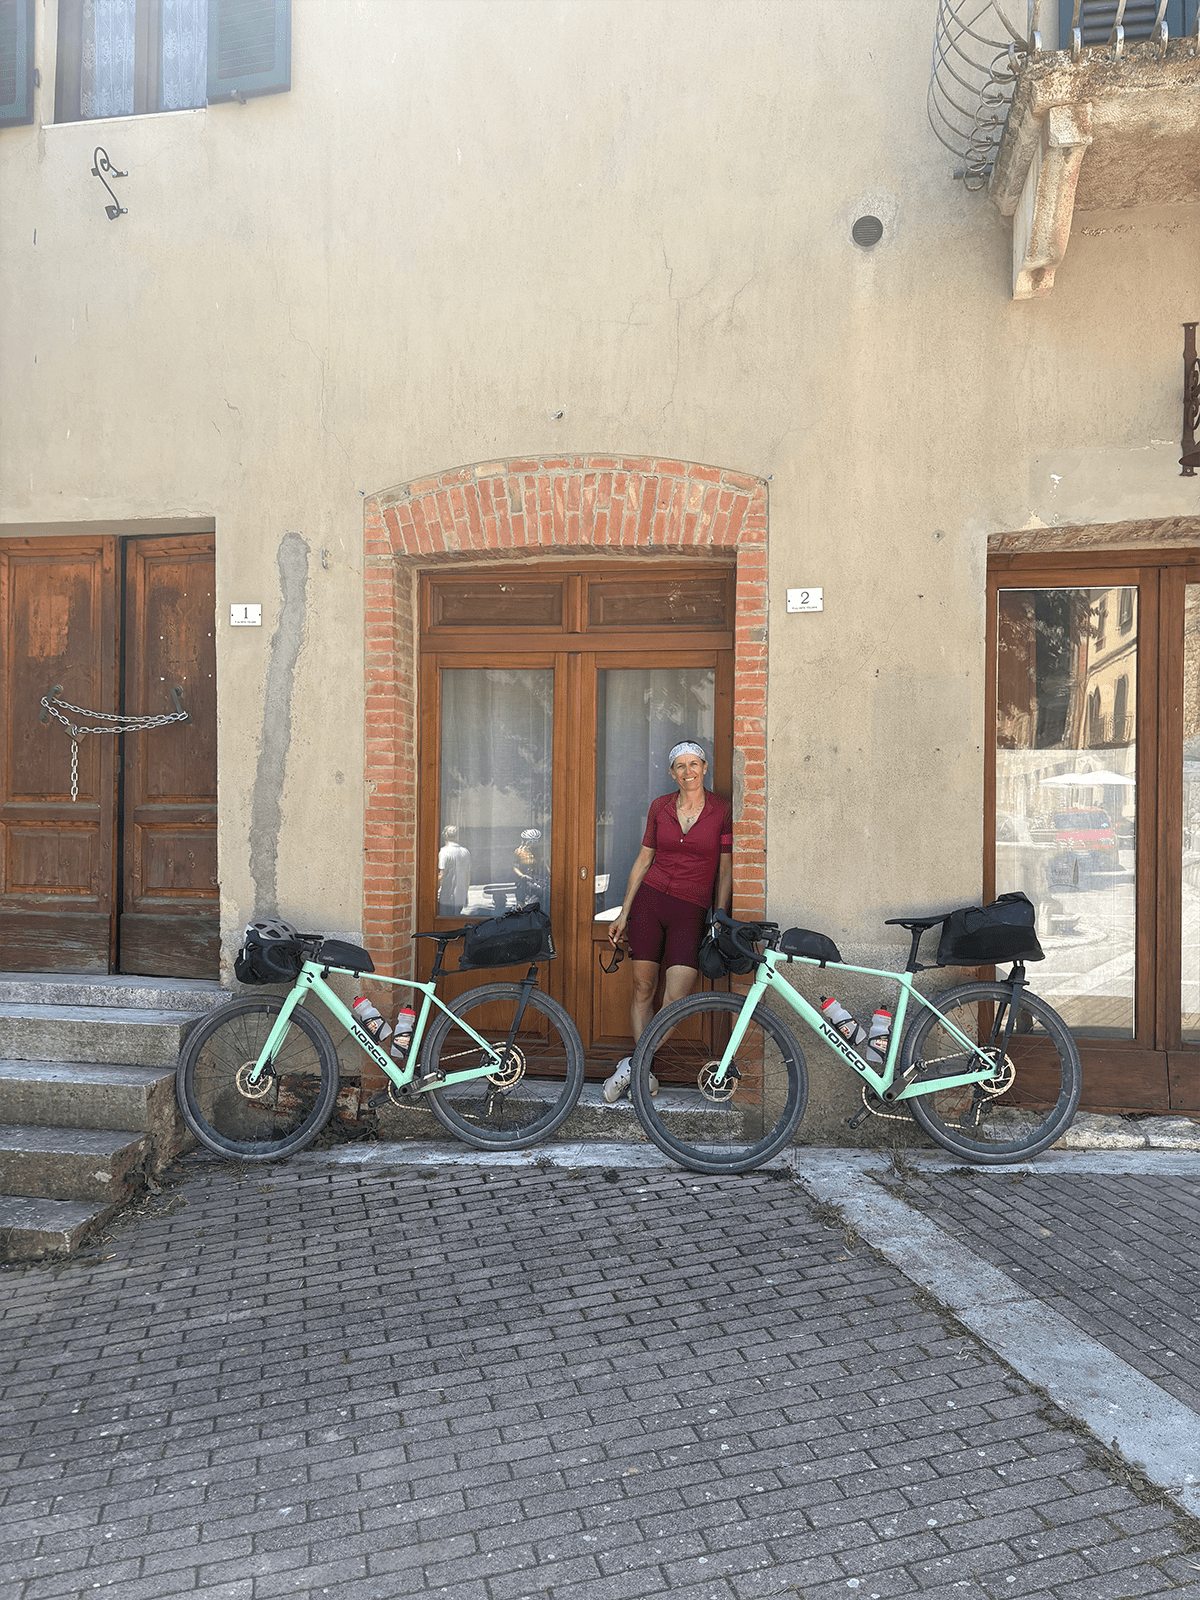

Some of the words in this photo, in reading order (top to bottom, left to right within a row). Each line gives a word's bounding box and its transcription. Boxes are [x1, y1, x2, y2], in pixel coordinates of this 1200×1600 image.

[801, 591, 810, 605] 2
[244, 606, 249, 620] 1
[350, 1024, 388, 1067] NORCO
[819, 1023, 866, 1071] NORCO
